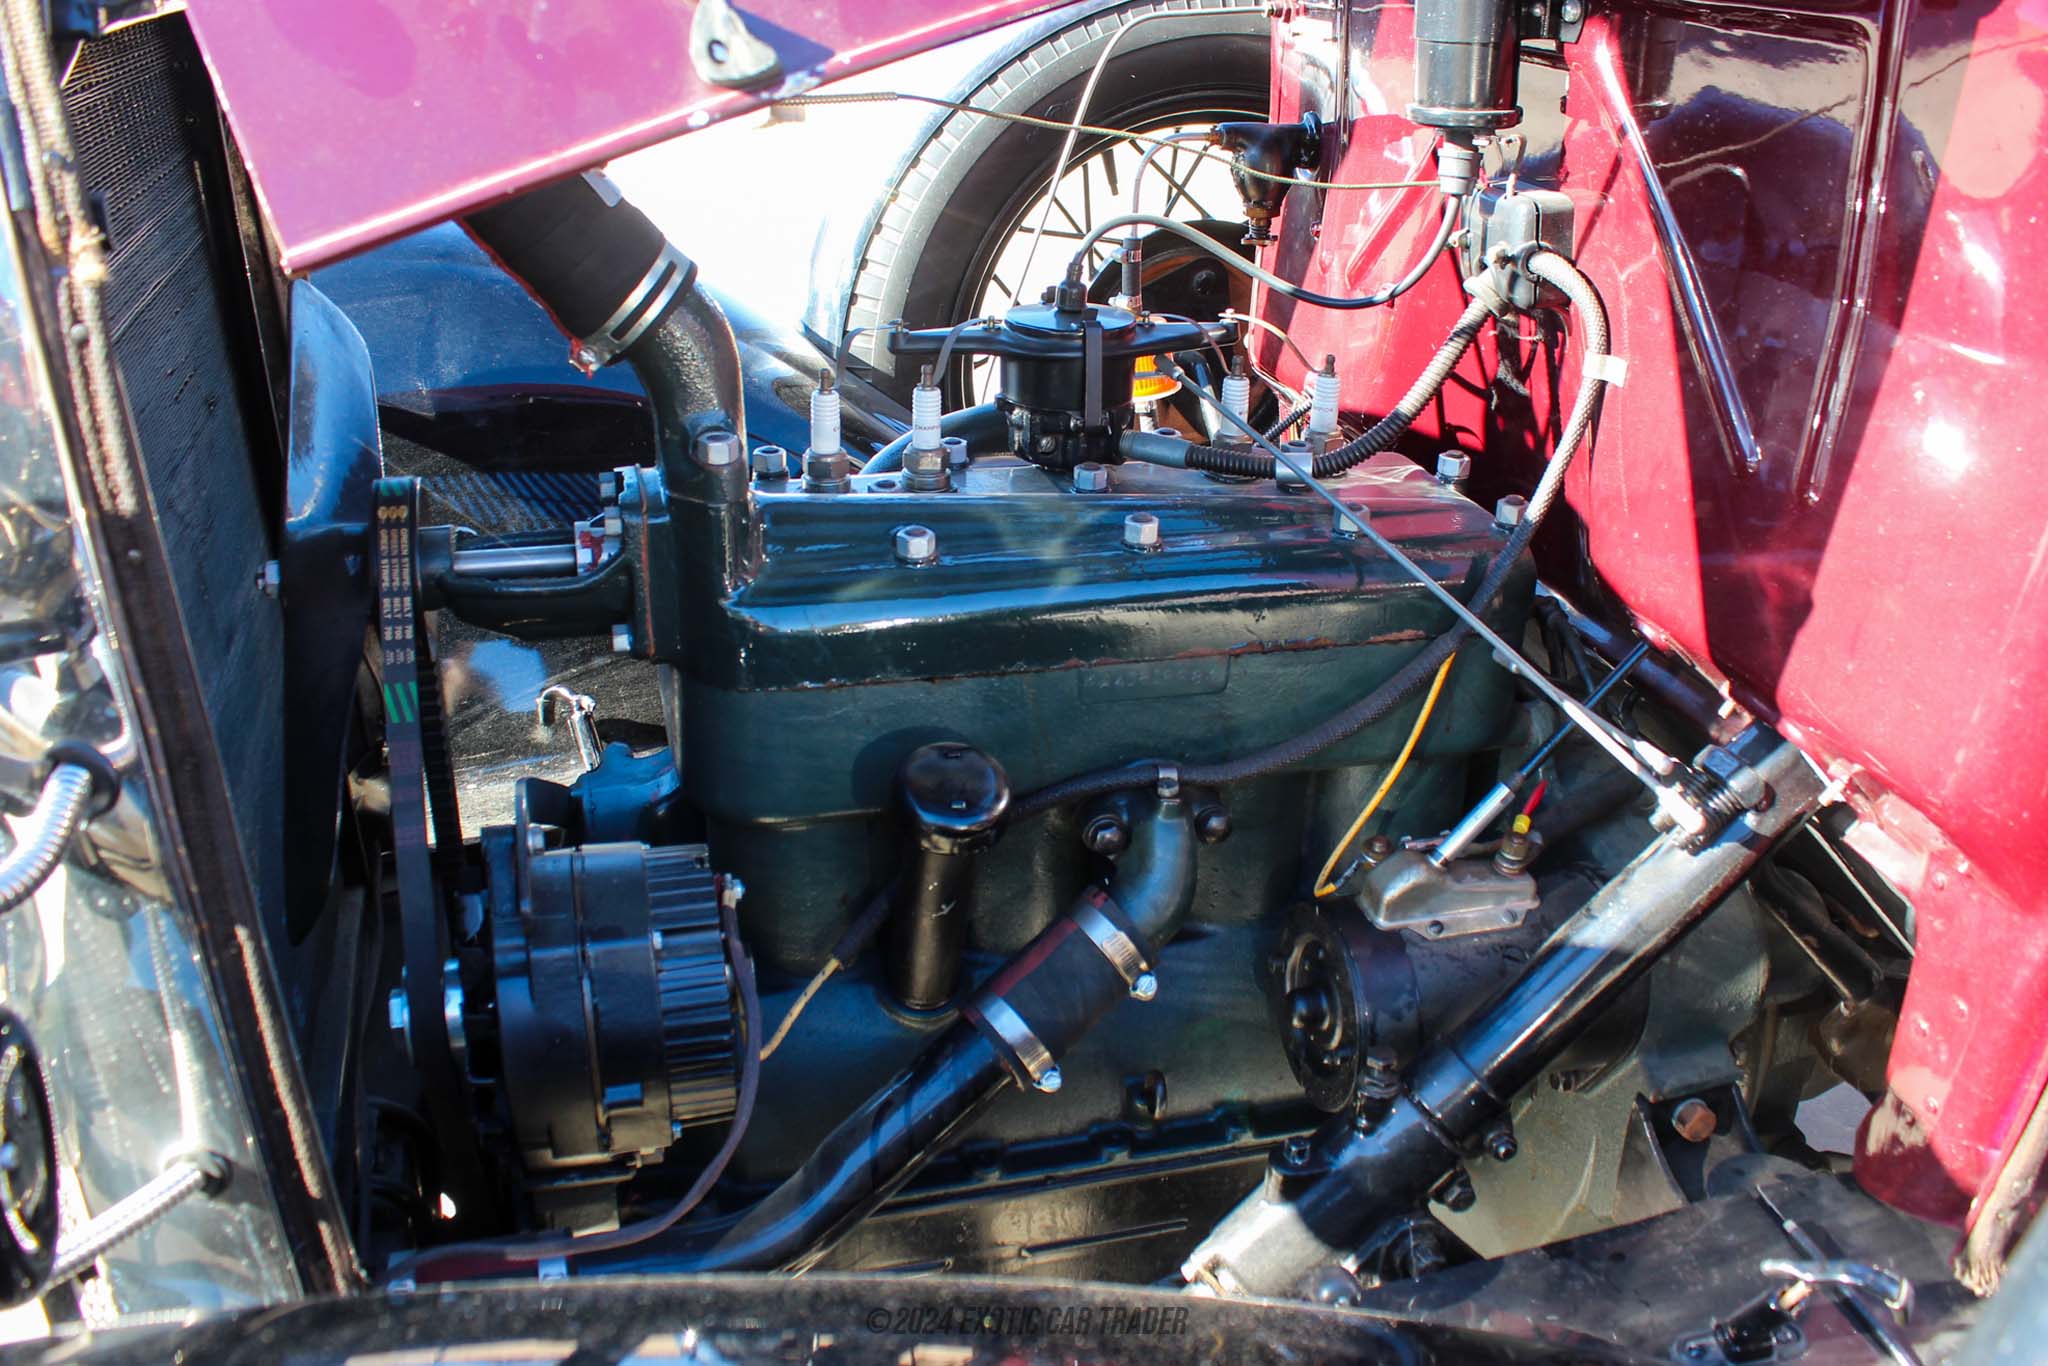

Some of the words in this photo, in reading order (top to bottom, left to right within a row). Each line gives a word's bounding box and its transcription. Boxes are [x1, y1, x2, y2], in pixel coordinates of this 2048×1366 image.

[400, 528, 409, 556] GREEN
[383, 597, 392, 618] BELT
[392, 597, 402, 618] BELT
[403, 596, 413, 618] BELT
